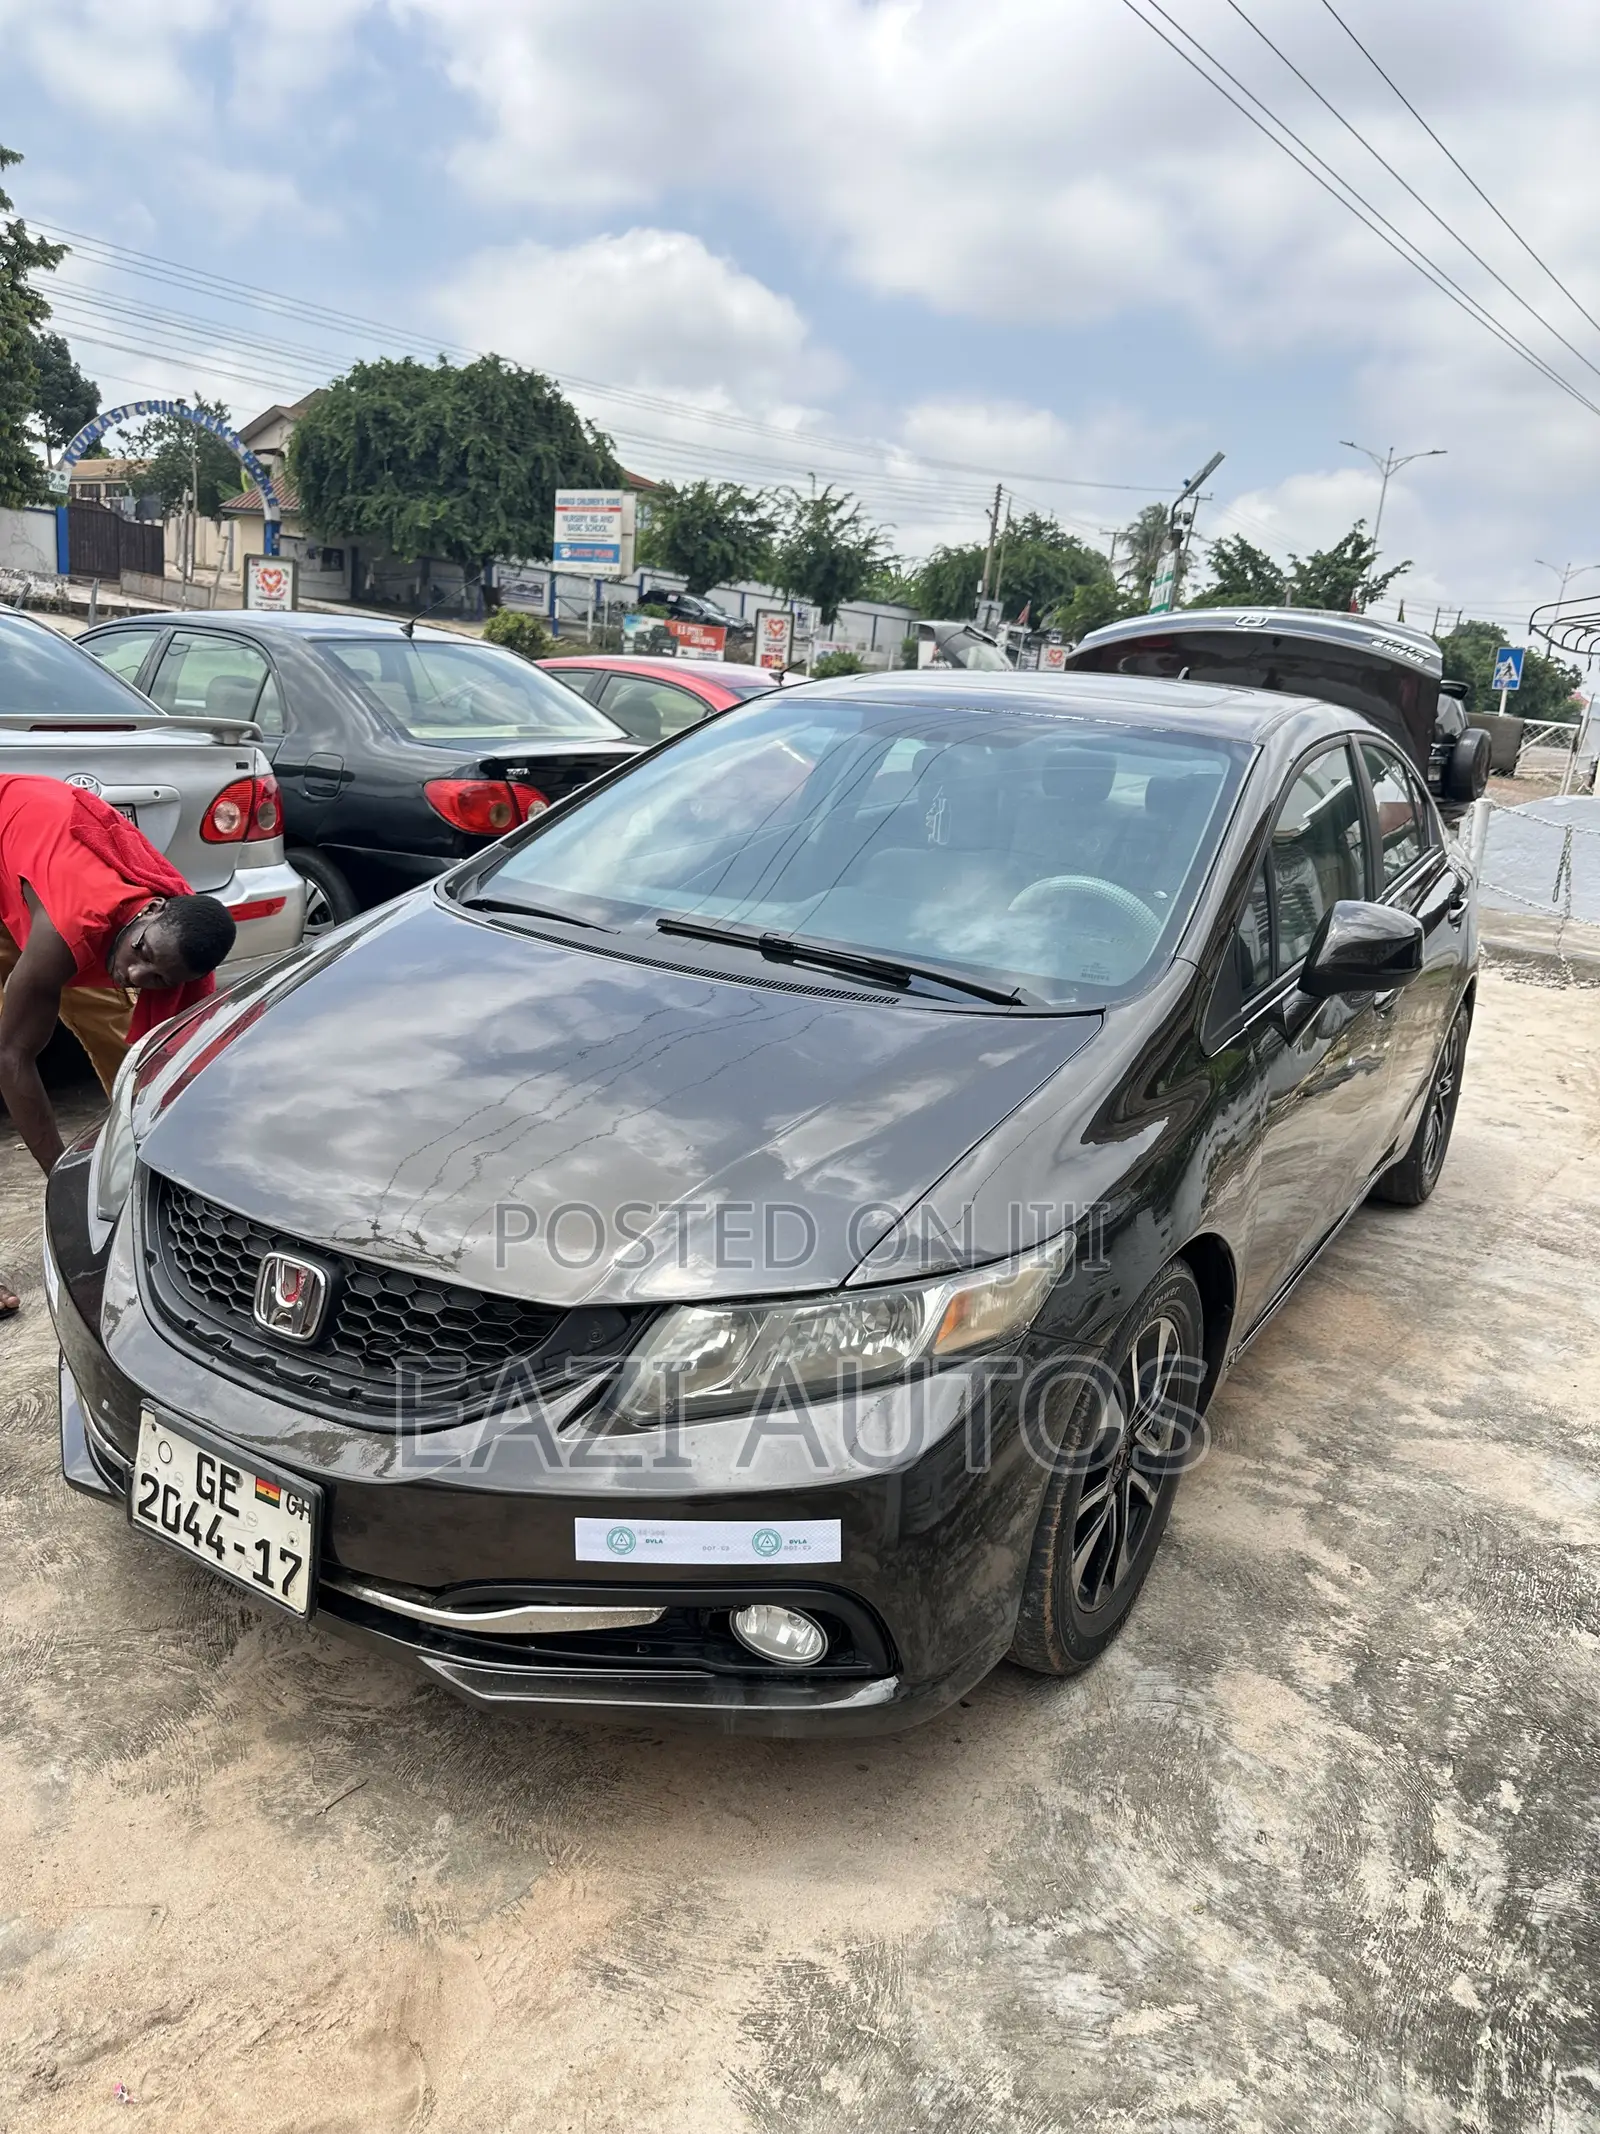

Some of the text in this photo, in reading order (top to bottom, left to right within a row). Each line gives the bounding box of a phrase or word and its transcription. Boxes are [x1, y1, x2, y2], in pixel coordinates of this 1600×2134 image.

[64, 404, 130, 466] KUMASI
[243, 450, 279, 507] HOME
[585, 524, 607, 532] SCHOOL
[196, 1451, 240, 1518] GE
[286, 1493, 311, 1524] GH
[138, 1472, 302, 1597] 2044-17
